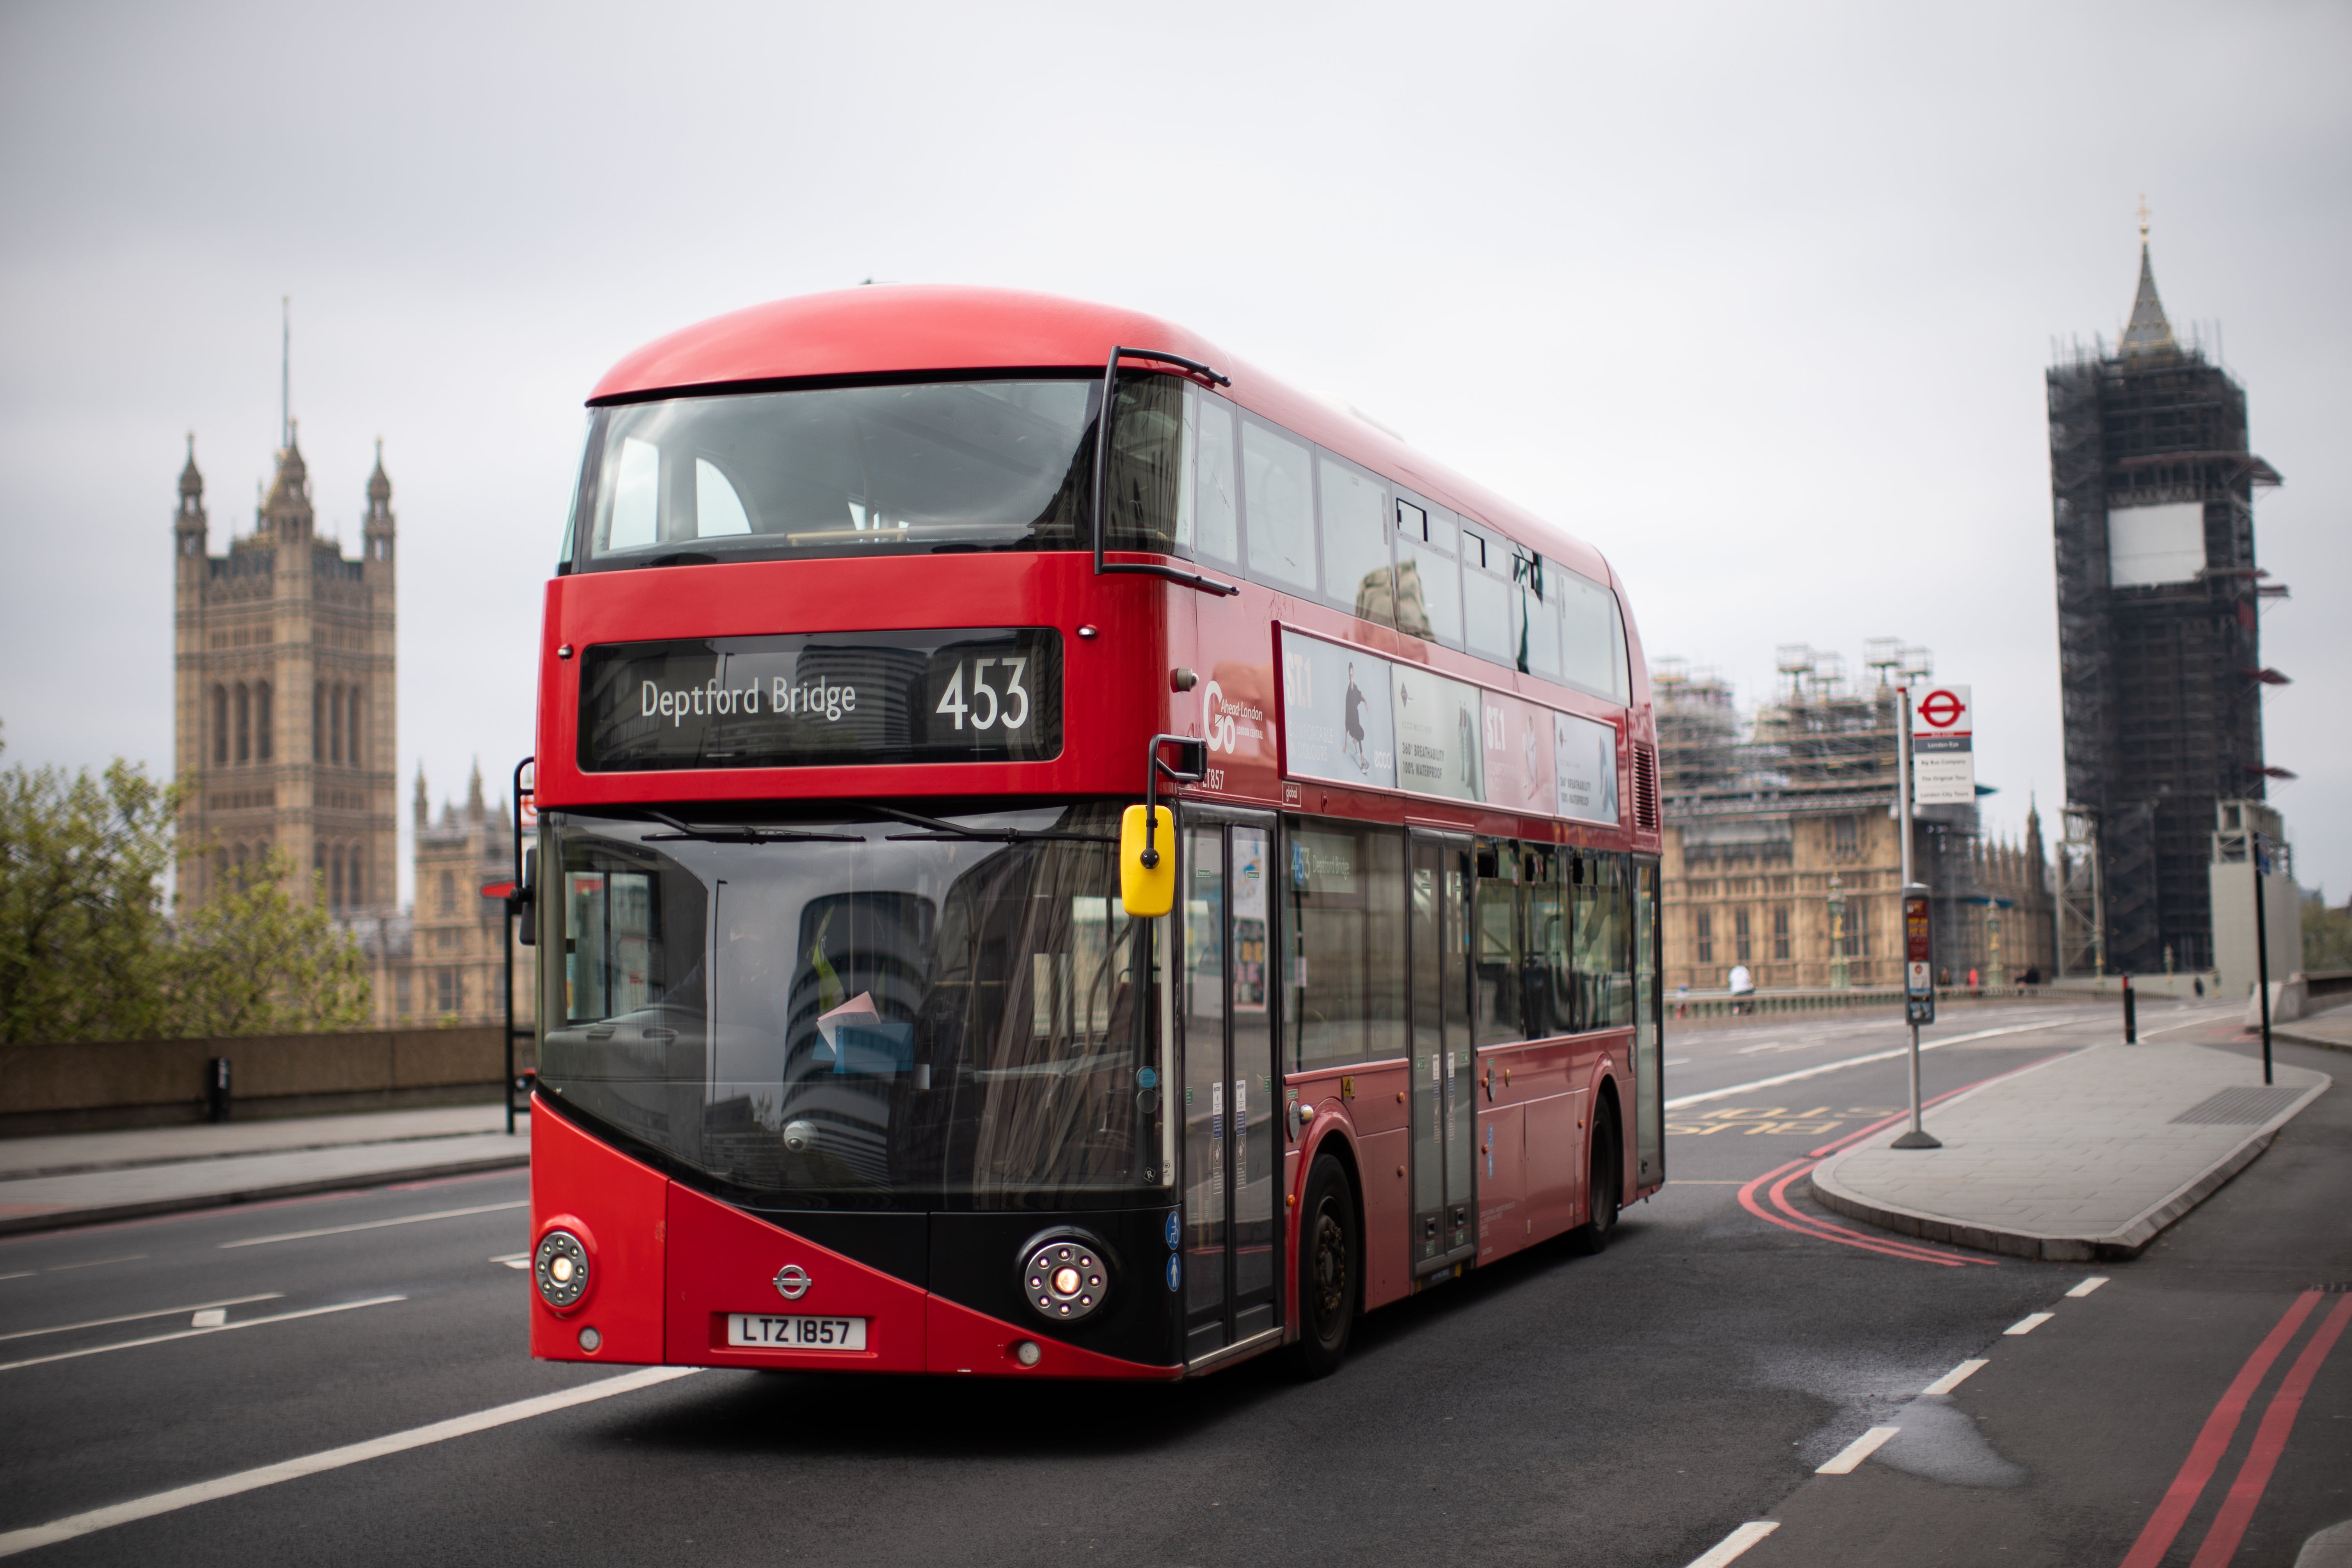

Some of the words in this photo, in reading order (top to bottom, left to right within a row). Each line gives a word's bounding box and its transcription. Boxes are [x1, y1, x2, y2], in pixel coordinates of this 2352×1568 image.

[1285, 651, 1312, 709] ST.1
[642, 677, 758, 728] Deptford
[773, 675, 856, 721] Bridge
[936, 657, 1029, 731] 453
[1203, 680, 1235, 754] Go
[1486, 705, 1506, 751] ST.1
[1237, 726, 1250, 737] LONDON
[1250, 727, 1263, 739] CENTRAL
[1288, 721, 1333, 744] COMFORTABLE
[1289, 740, 1296, 757] IN
[1298, 742, 1328, 762] COLOURS
[1374, 750, 1392, 769] ecco
[1414, 744, 1445, 762] BREATHABILITY
[1403, 761, 1414, 775] 100%
[1415, 763, 1443, 780] WATERPROOF
[1286, 785, 1298, 802] global
[1291, 847, 1311, 880] 453
[1313, 854, 1335, 879] Deptford
[1335, 857, 1350, 880] Bridge
[743, 1317, 789, 1342] LTZ
[796, 1319, 850, 1345] 1857
